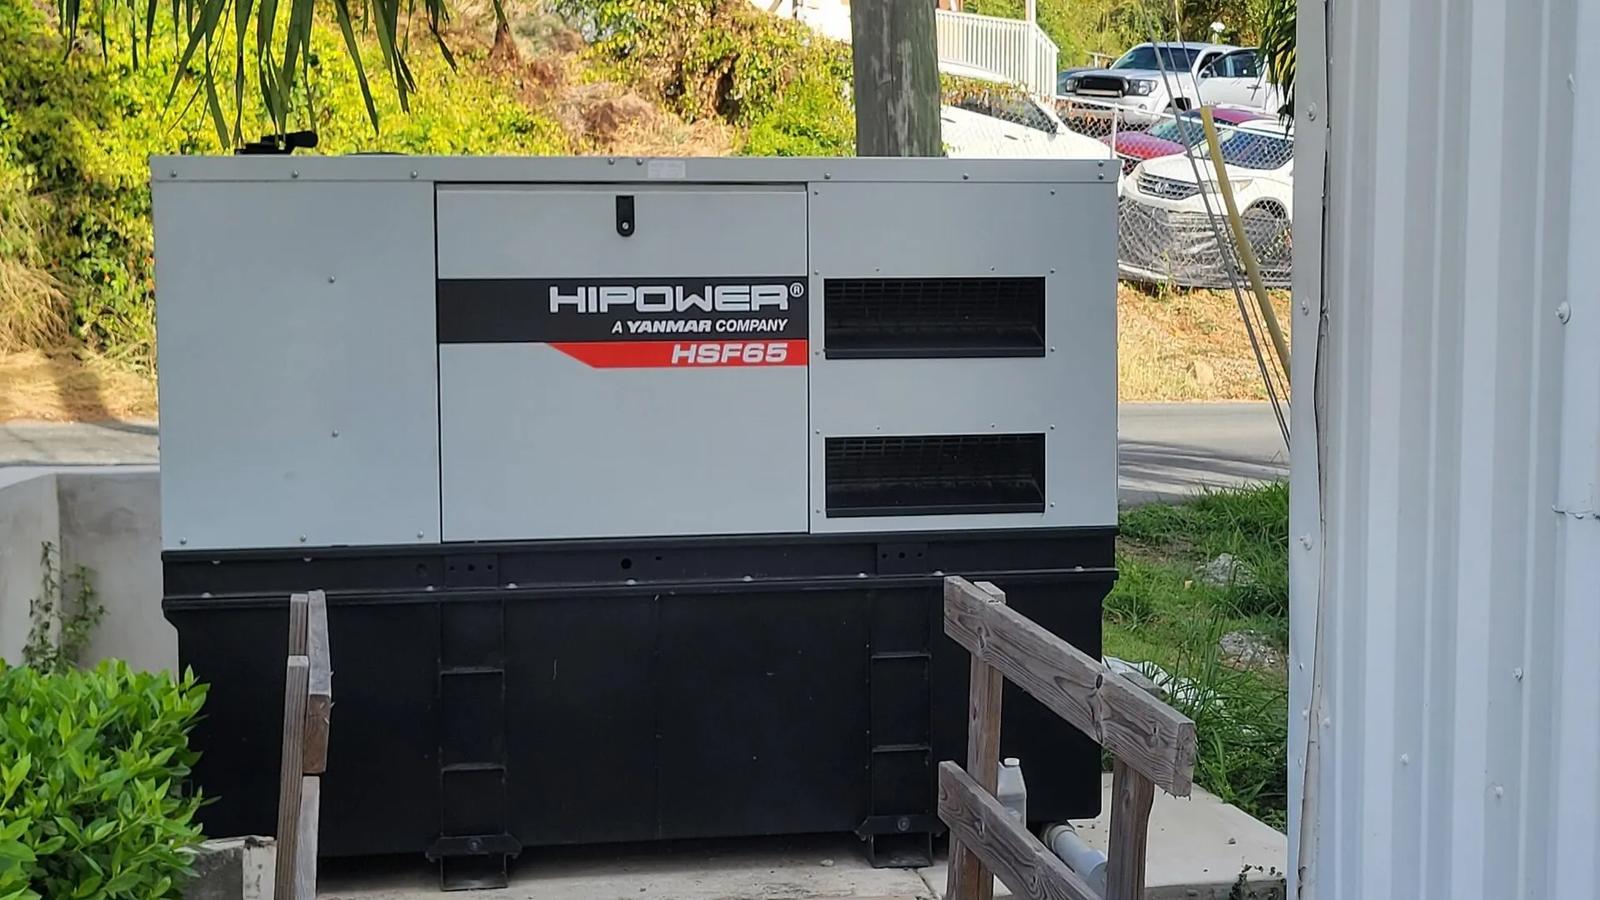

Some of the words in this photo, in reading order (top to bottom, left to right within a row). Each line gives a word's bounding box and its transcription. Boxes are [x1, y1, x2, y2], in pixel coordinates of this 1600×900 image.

[611, 321, 623, 334] A
[626, 320, 712, 334] YANMAR
[715, 319, 788, 333] COMPANY
[671, 343, 788, 364] HSF65
